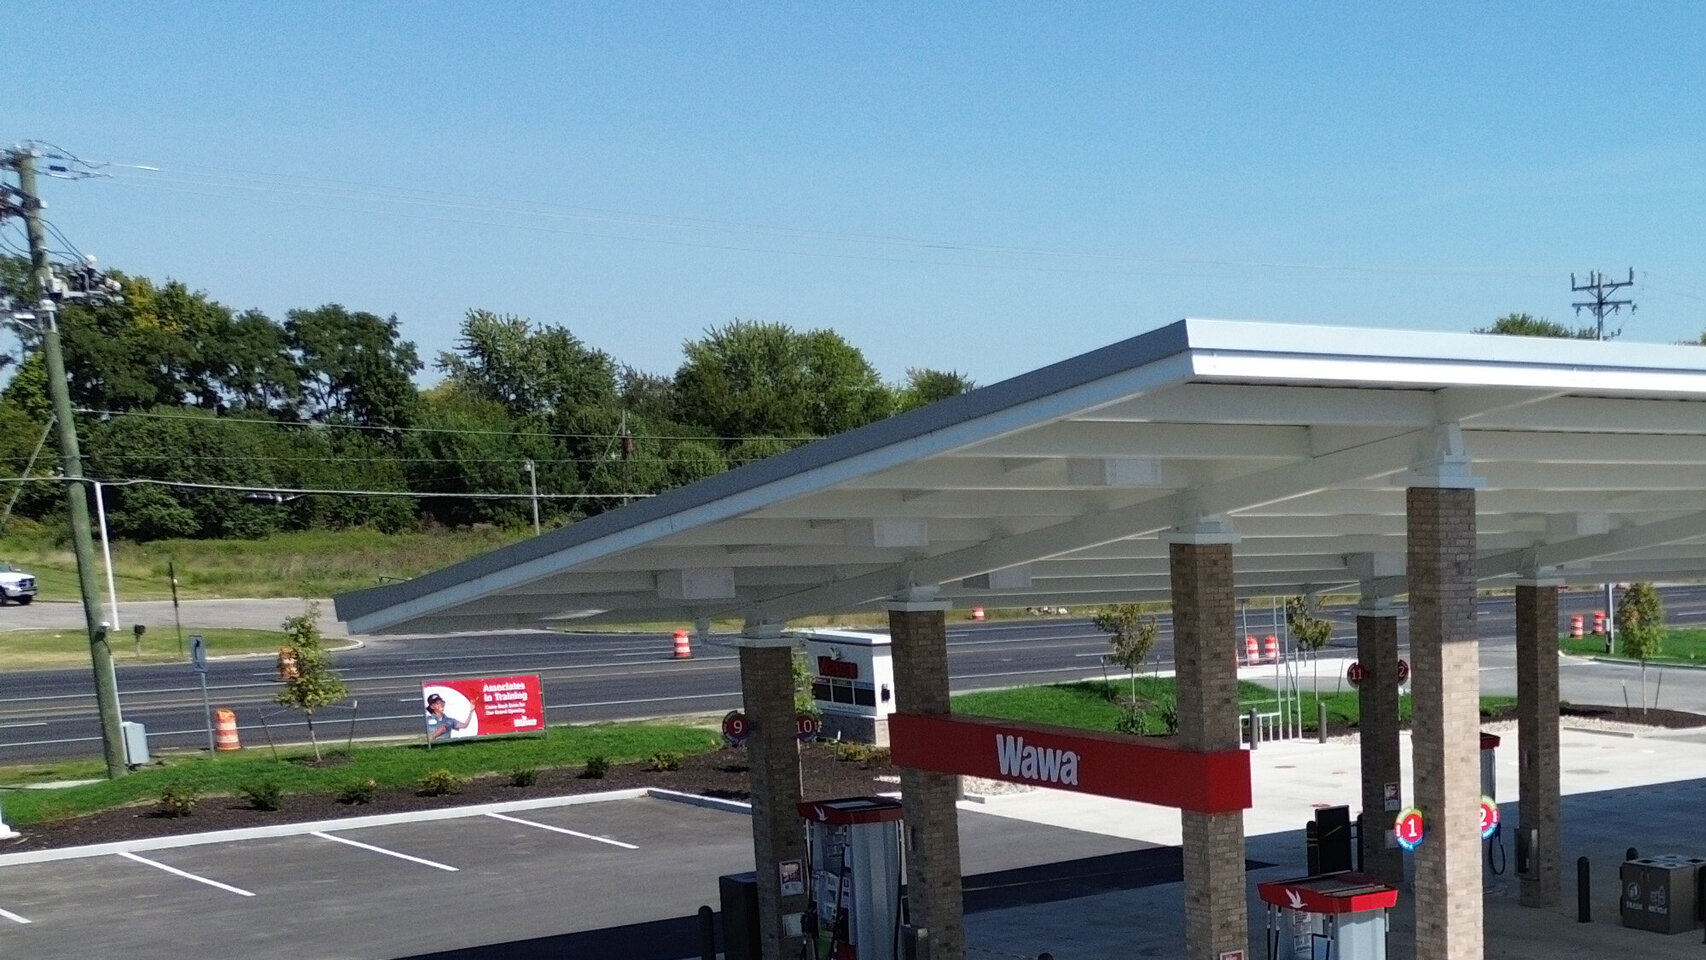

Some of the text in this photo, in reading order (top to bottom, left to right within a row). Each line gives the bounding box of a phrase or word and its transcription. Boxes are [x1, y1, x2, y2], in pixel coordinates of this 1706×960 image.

[483, 682, 526, 692] Associates
[495, 692, 528, 701] Training
[733, 720, 743, 734] 9
[796, 719, 813, 734] 10
[996, 734, 1079, 786] Wawa
[1480, 808, 1488, 827] 2
[1408, 818, 1418, 837] 1
